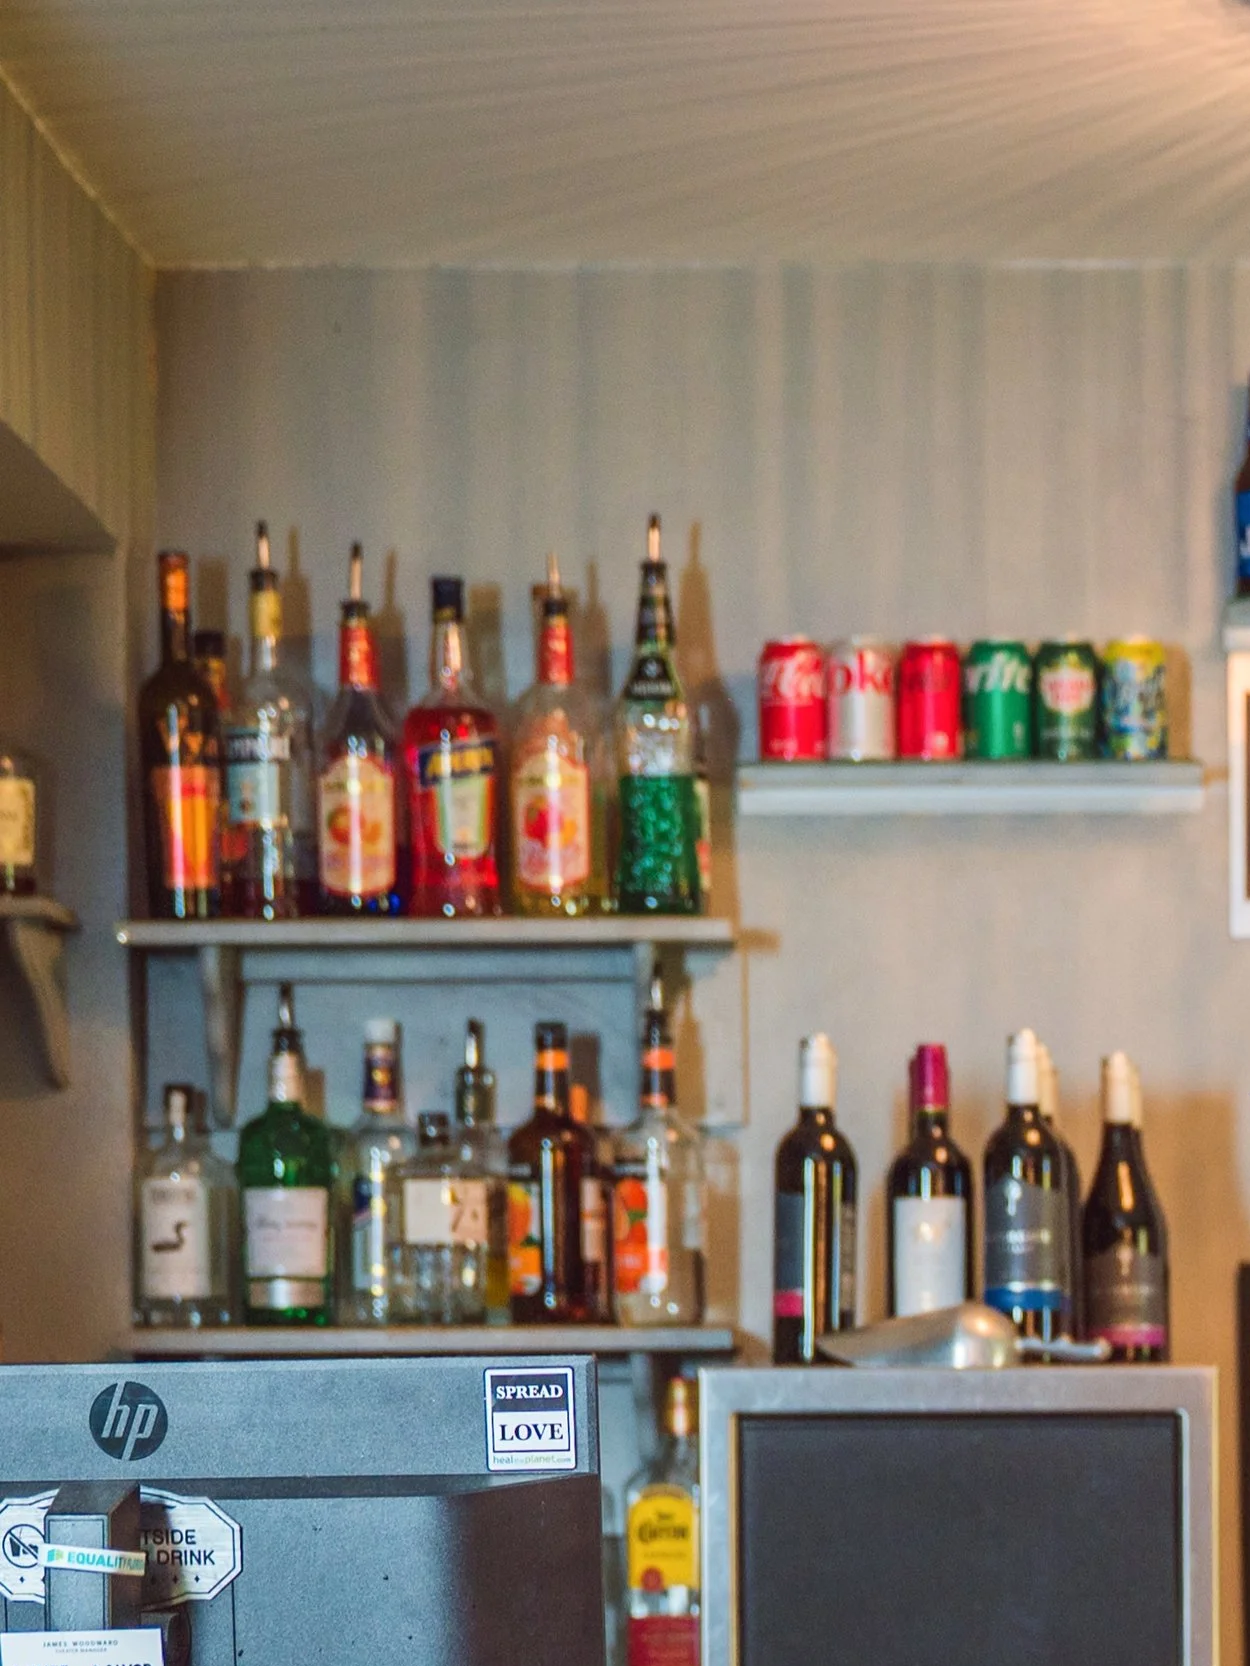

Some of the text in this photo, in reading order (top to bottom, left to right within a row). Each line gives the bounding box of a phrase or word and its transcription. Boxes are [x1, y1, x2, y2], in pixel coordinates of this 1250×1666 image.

[496, 1384, 563, 1400] SPREAD
[101, 1382, 159, 1460] hp
[499, 1423, 564, 1441] LOVE
[141, 1528, 197, 1546] TSIDE
[157, 1549, 216, 1566] DRINK
